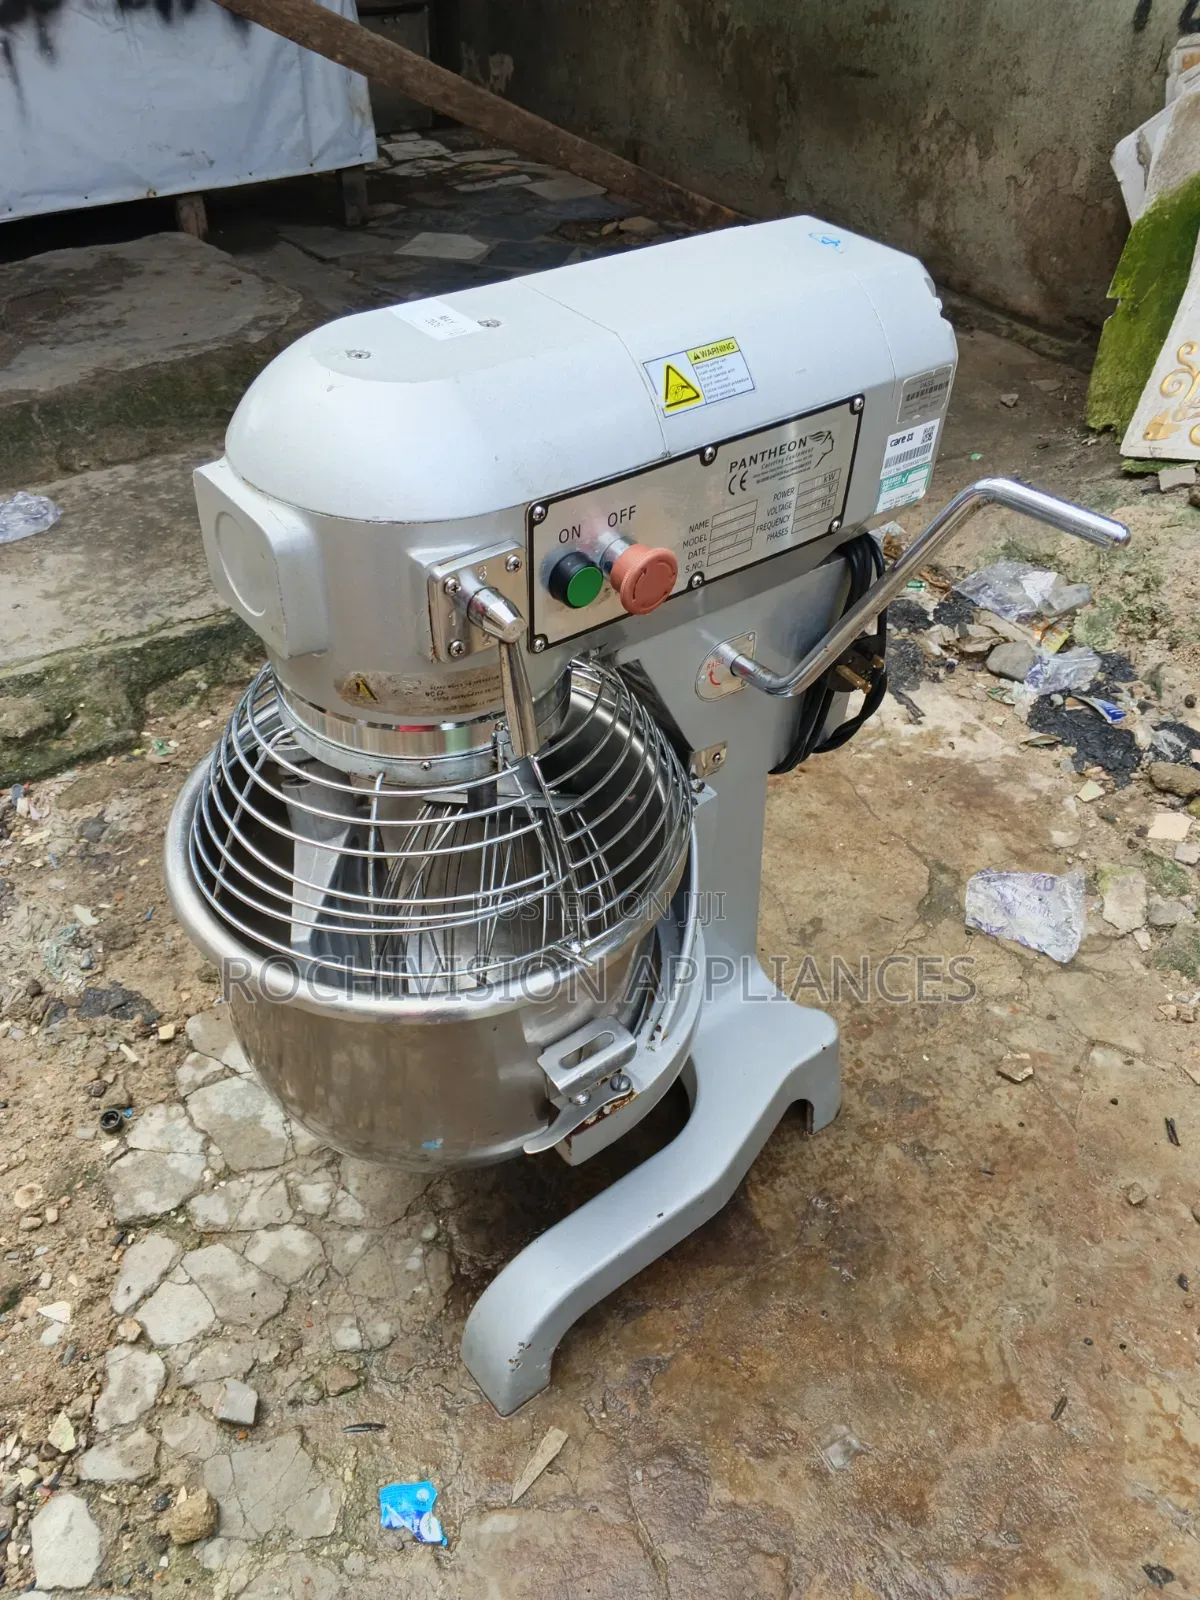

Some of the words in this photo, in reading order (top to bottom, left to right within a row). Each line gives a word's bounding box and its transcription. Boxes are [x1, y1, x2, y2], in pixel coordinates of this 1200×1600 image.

[699, 342, 735, 358] WARNING
[890, 436, 906, 447] care
[729, 436, 808, 473] PANTHEON
[773, 487, 795, 502] POWER
[824, 472, 836, 483] kW
[766, 500, 793, 516] VOLTAGE
[828, 484, 834, 494] V
[607, 505, 636, 527] OFF
[756, 514, 791, 534] FREQUENCY
[821, 499, 831, 509] Hz
[558, 524, 581, 543] ON
[689, 518, 710, 534] NAME
[682, 534, 708, 550] MODEL
[766, 528, 789, 542] PHASES
[688, 546, 706, 560] DATE
[479, 566, 487, 581] 3
[685, 560, 704, 574] S.NO.
[707, 656, 725, 669] RAISE
